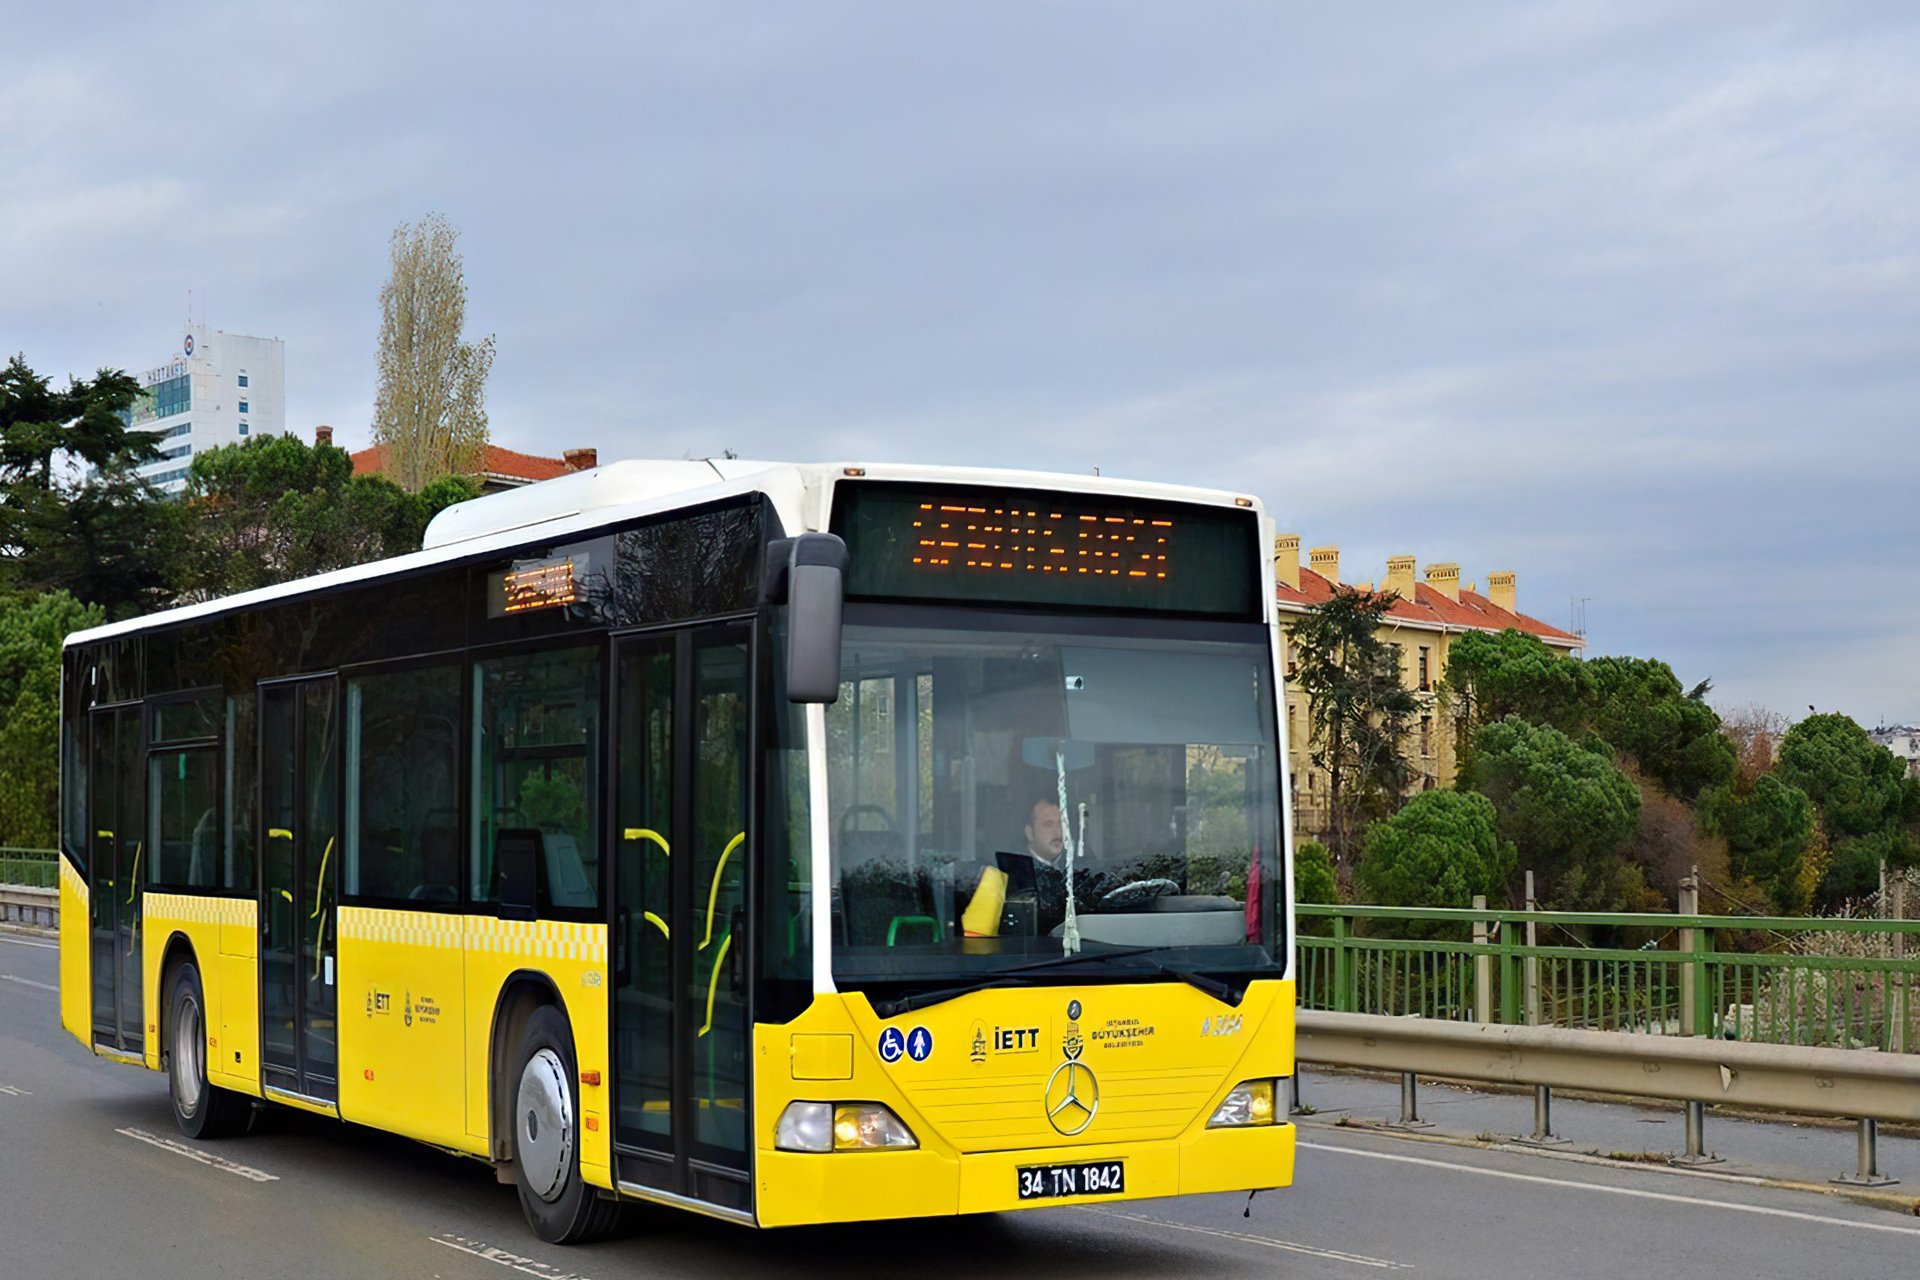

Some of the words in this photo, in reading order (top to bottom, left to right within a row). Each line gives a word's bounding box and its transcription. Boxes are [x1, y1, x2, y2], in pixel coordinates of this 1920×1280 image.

[1021, 1170, 1043, 1196] 34
[1050, 1168, 1076, 1195] TN
[1082, 1165, 1120, 1191] 1842
